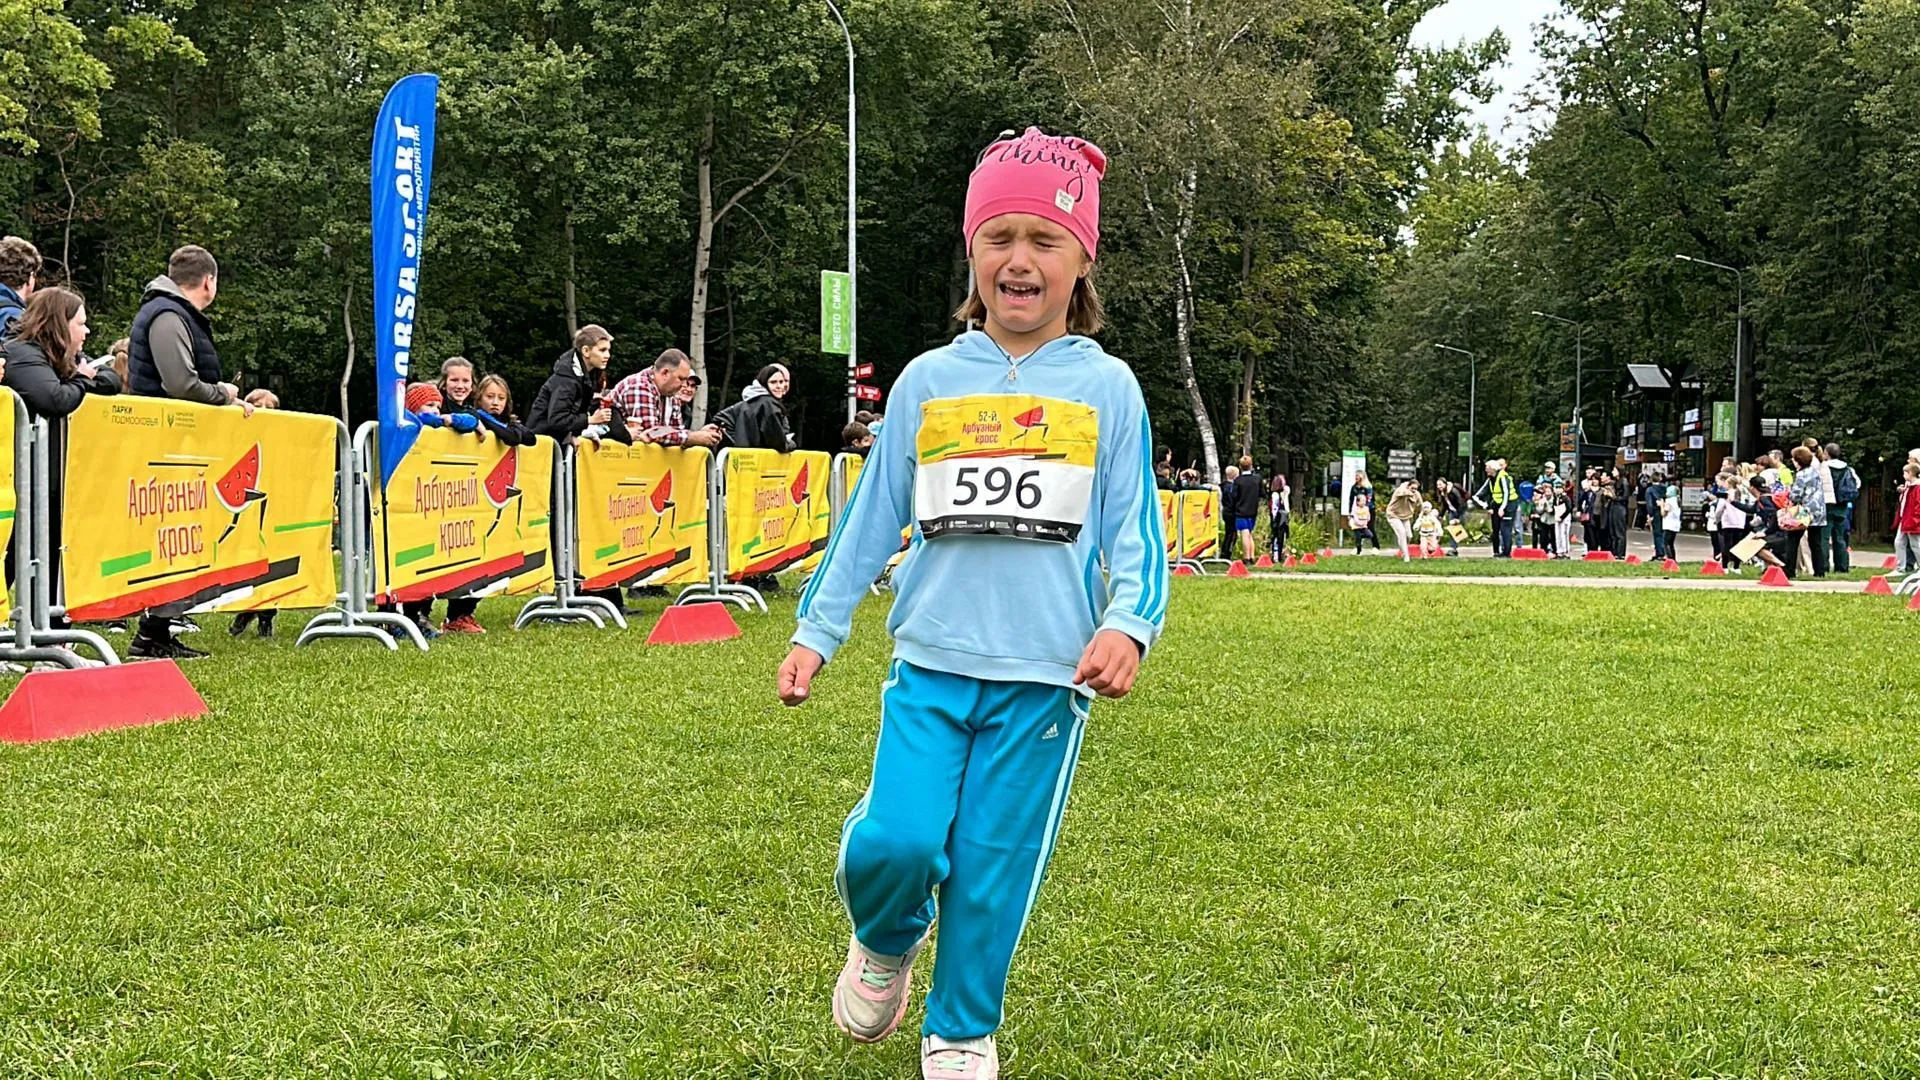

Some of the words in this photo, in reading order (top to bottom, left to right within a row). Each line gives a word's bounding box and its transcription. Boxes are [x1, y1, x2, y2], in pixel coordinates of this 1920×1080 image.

[832, 278, 841, 310] СИЛЫ
[832, 313, 841, 350] МЕСТО
[962, 421, 1002, 435] Арбузный
[975, 434, 999, 444] кросс
[128, 472, 207, 524] Арбузный
[414, 472, 479, 518] Арбузный
[953, 467, 1042, 509] 596
[608, 490, 647, 526] Арбузный
[157, 523, 203, 566] кросс
[440, 519, 476, 557] кросс
[622, 525, 645, 553] кросс
